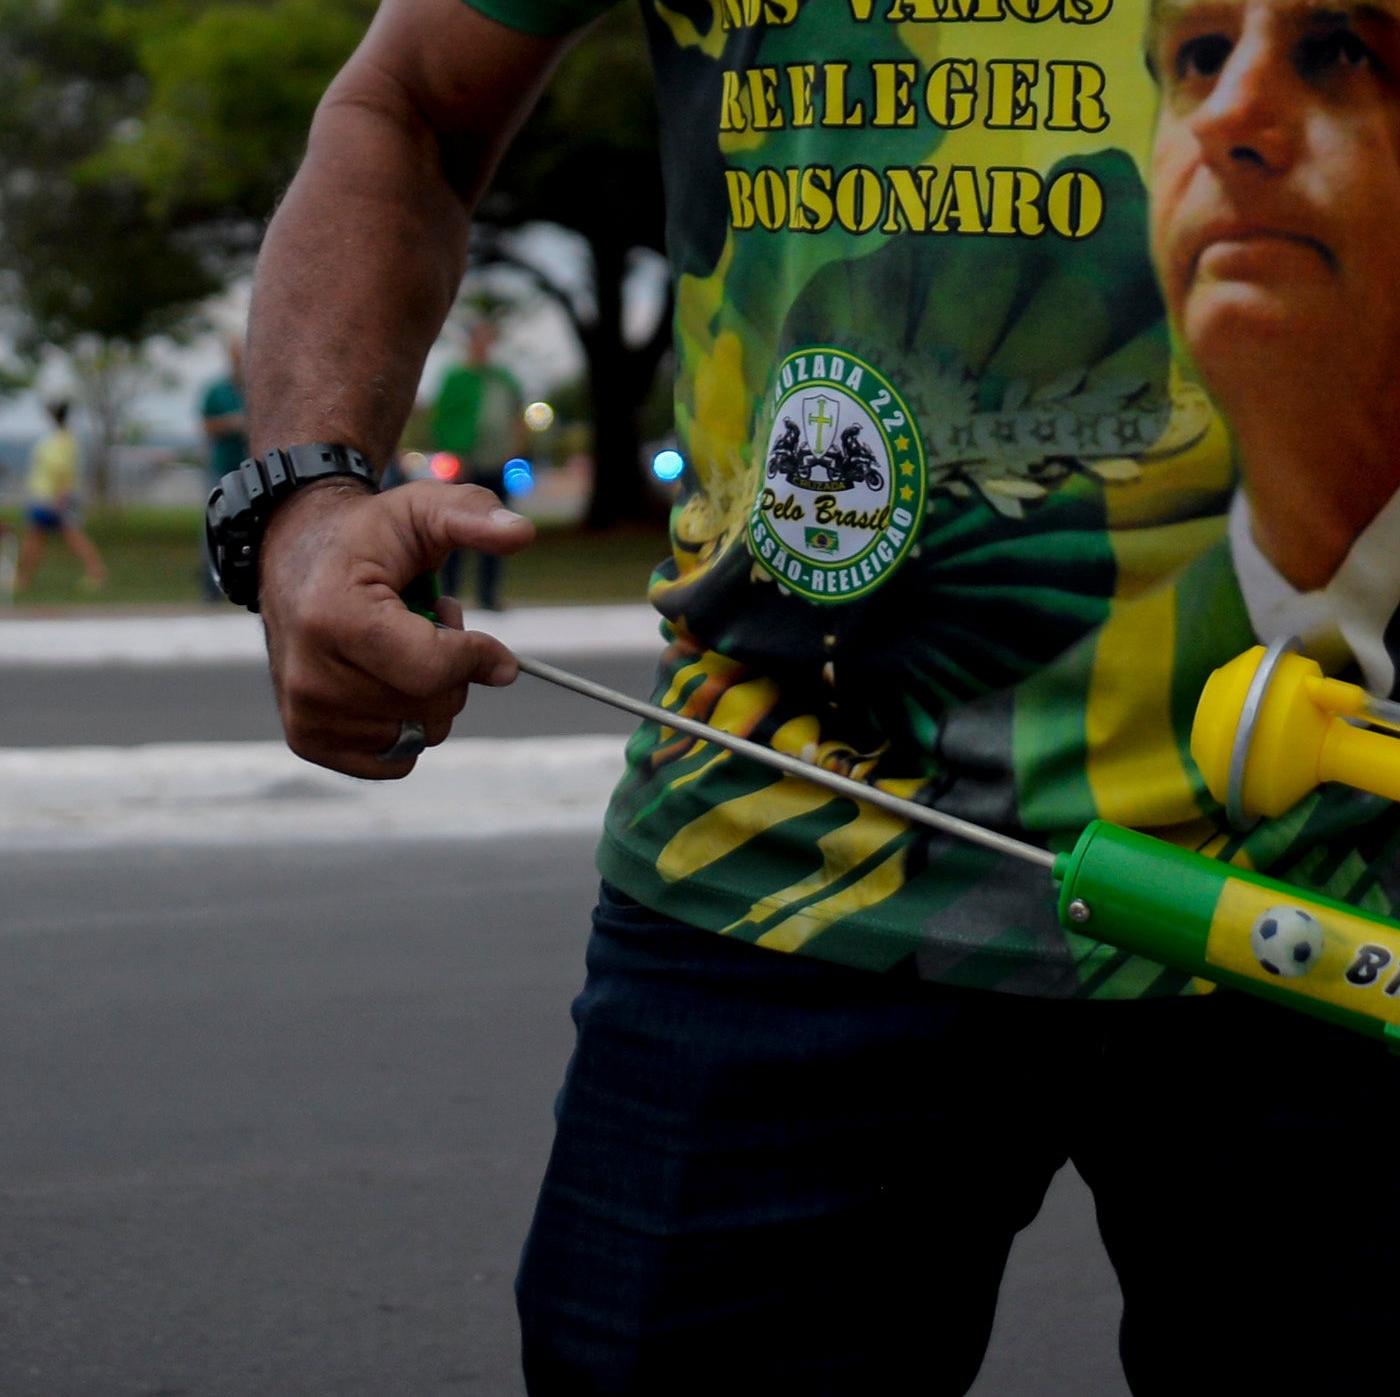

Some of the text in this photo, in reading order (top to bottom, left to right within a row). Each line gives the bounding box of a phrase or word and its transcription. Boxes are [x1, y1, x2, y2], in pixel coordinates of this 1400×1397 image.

[718, 58, 1111, 132] REELEGER
[723, 163, 1106, 241] BOLSONARO
[869, 389, 906, 433] 22
[792, 475, 847, 492] CRUZADA
[760, 487, 891, 533] Pelo Brasil
